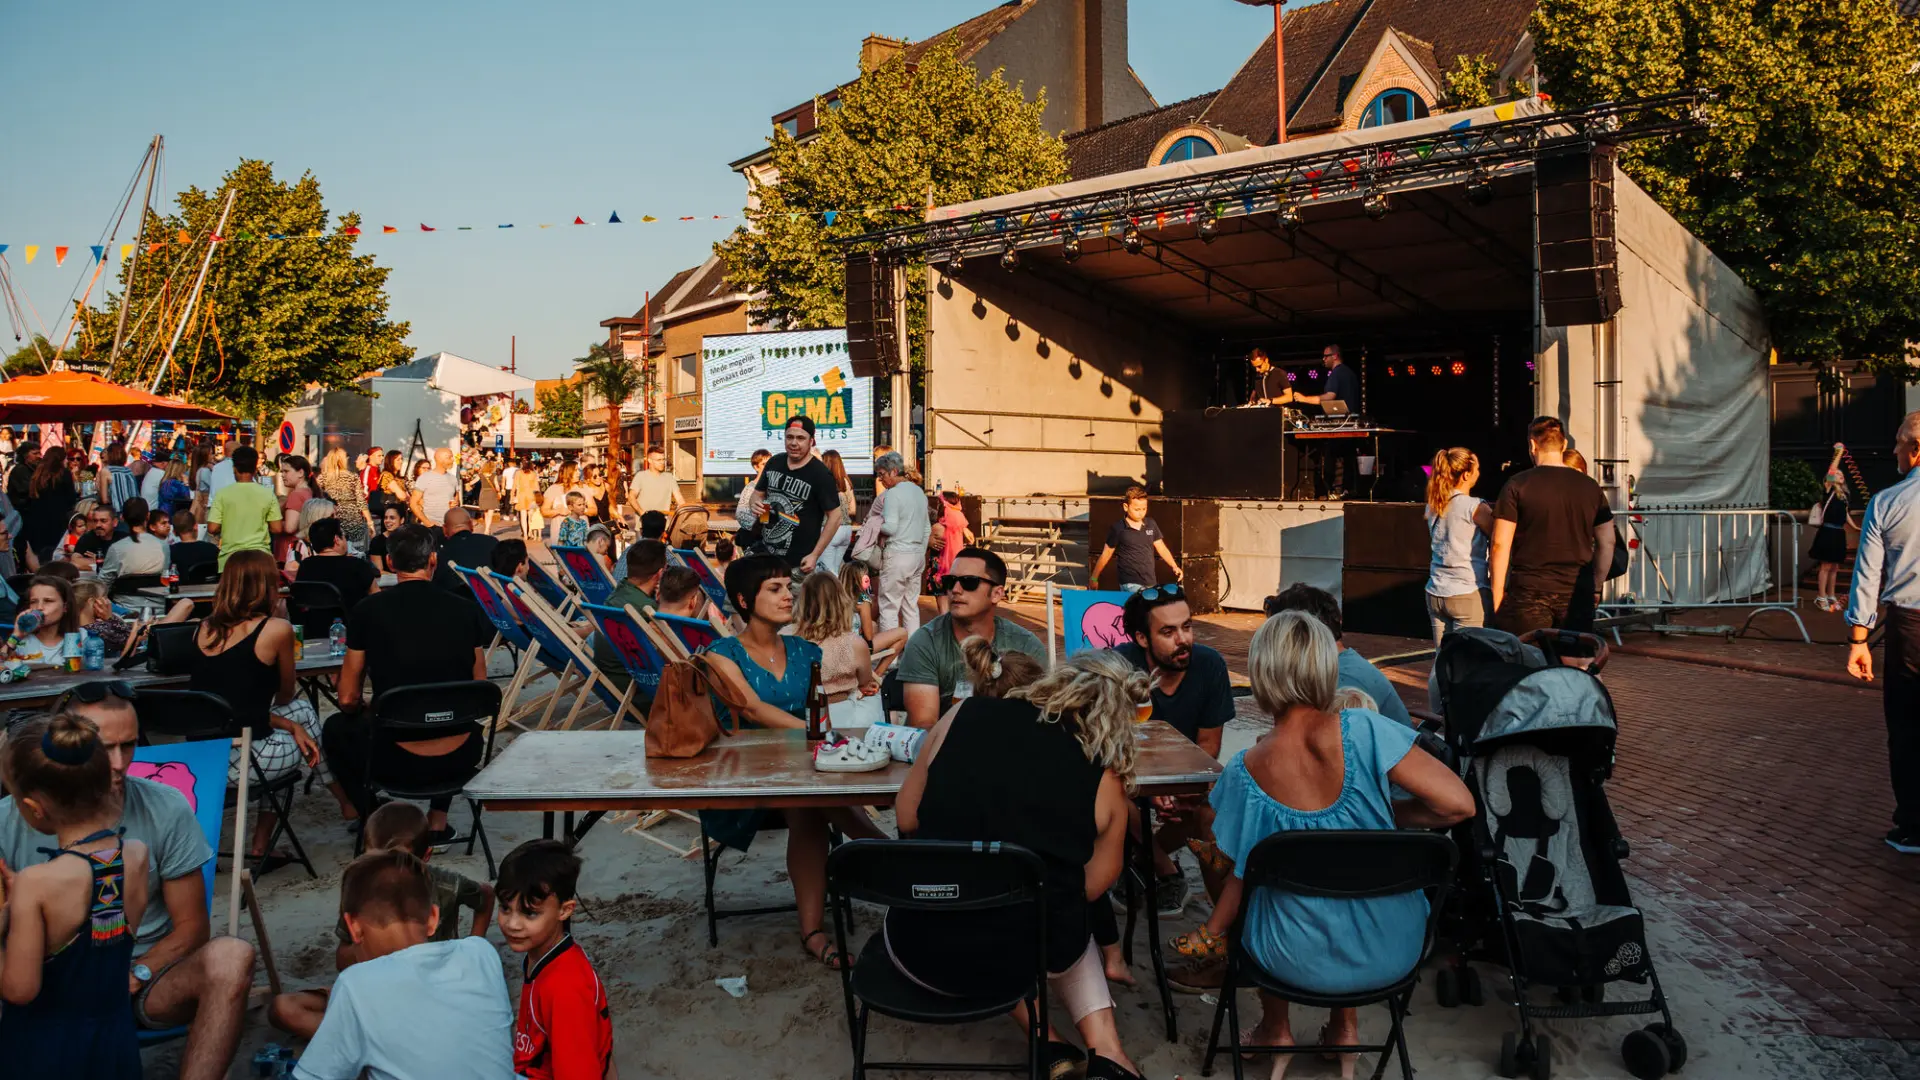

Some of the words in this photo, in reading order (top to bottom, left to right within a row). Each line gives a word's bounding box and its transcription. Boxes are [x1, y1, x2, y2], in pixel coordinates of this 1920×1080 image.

[710, 363, 728, 375] Mede
[729, 353, 756, 369] mogelijk
[712, 371, 739, 387] gemaakt
[767, 392, 847, 426] GEMA
[766, 429, 848, 441] PLICS
[781, 475, 812, 501] FLOYD
